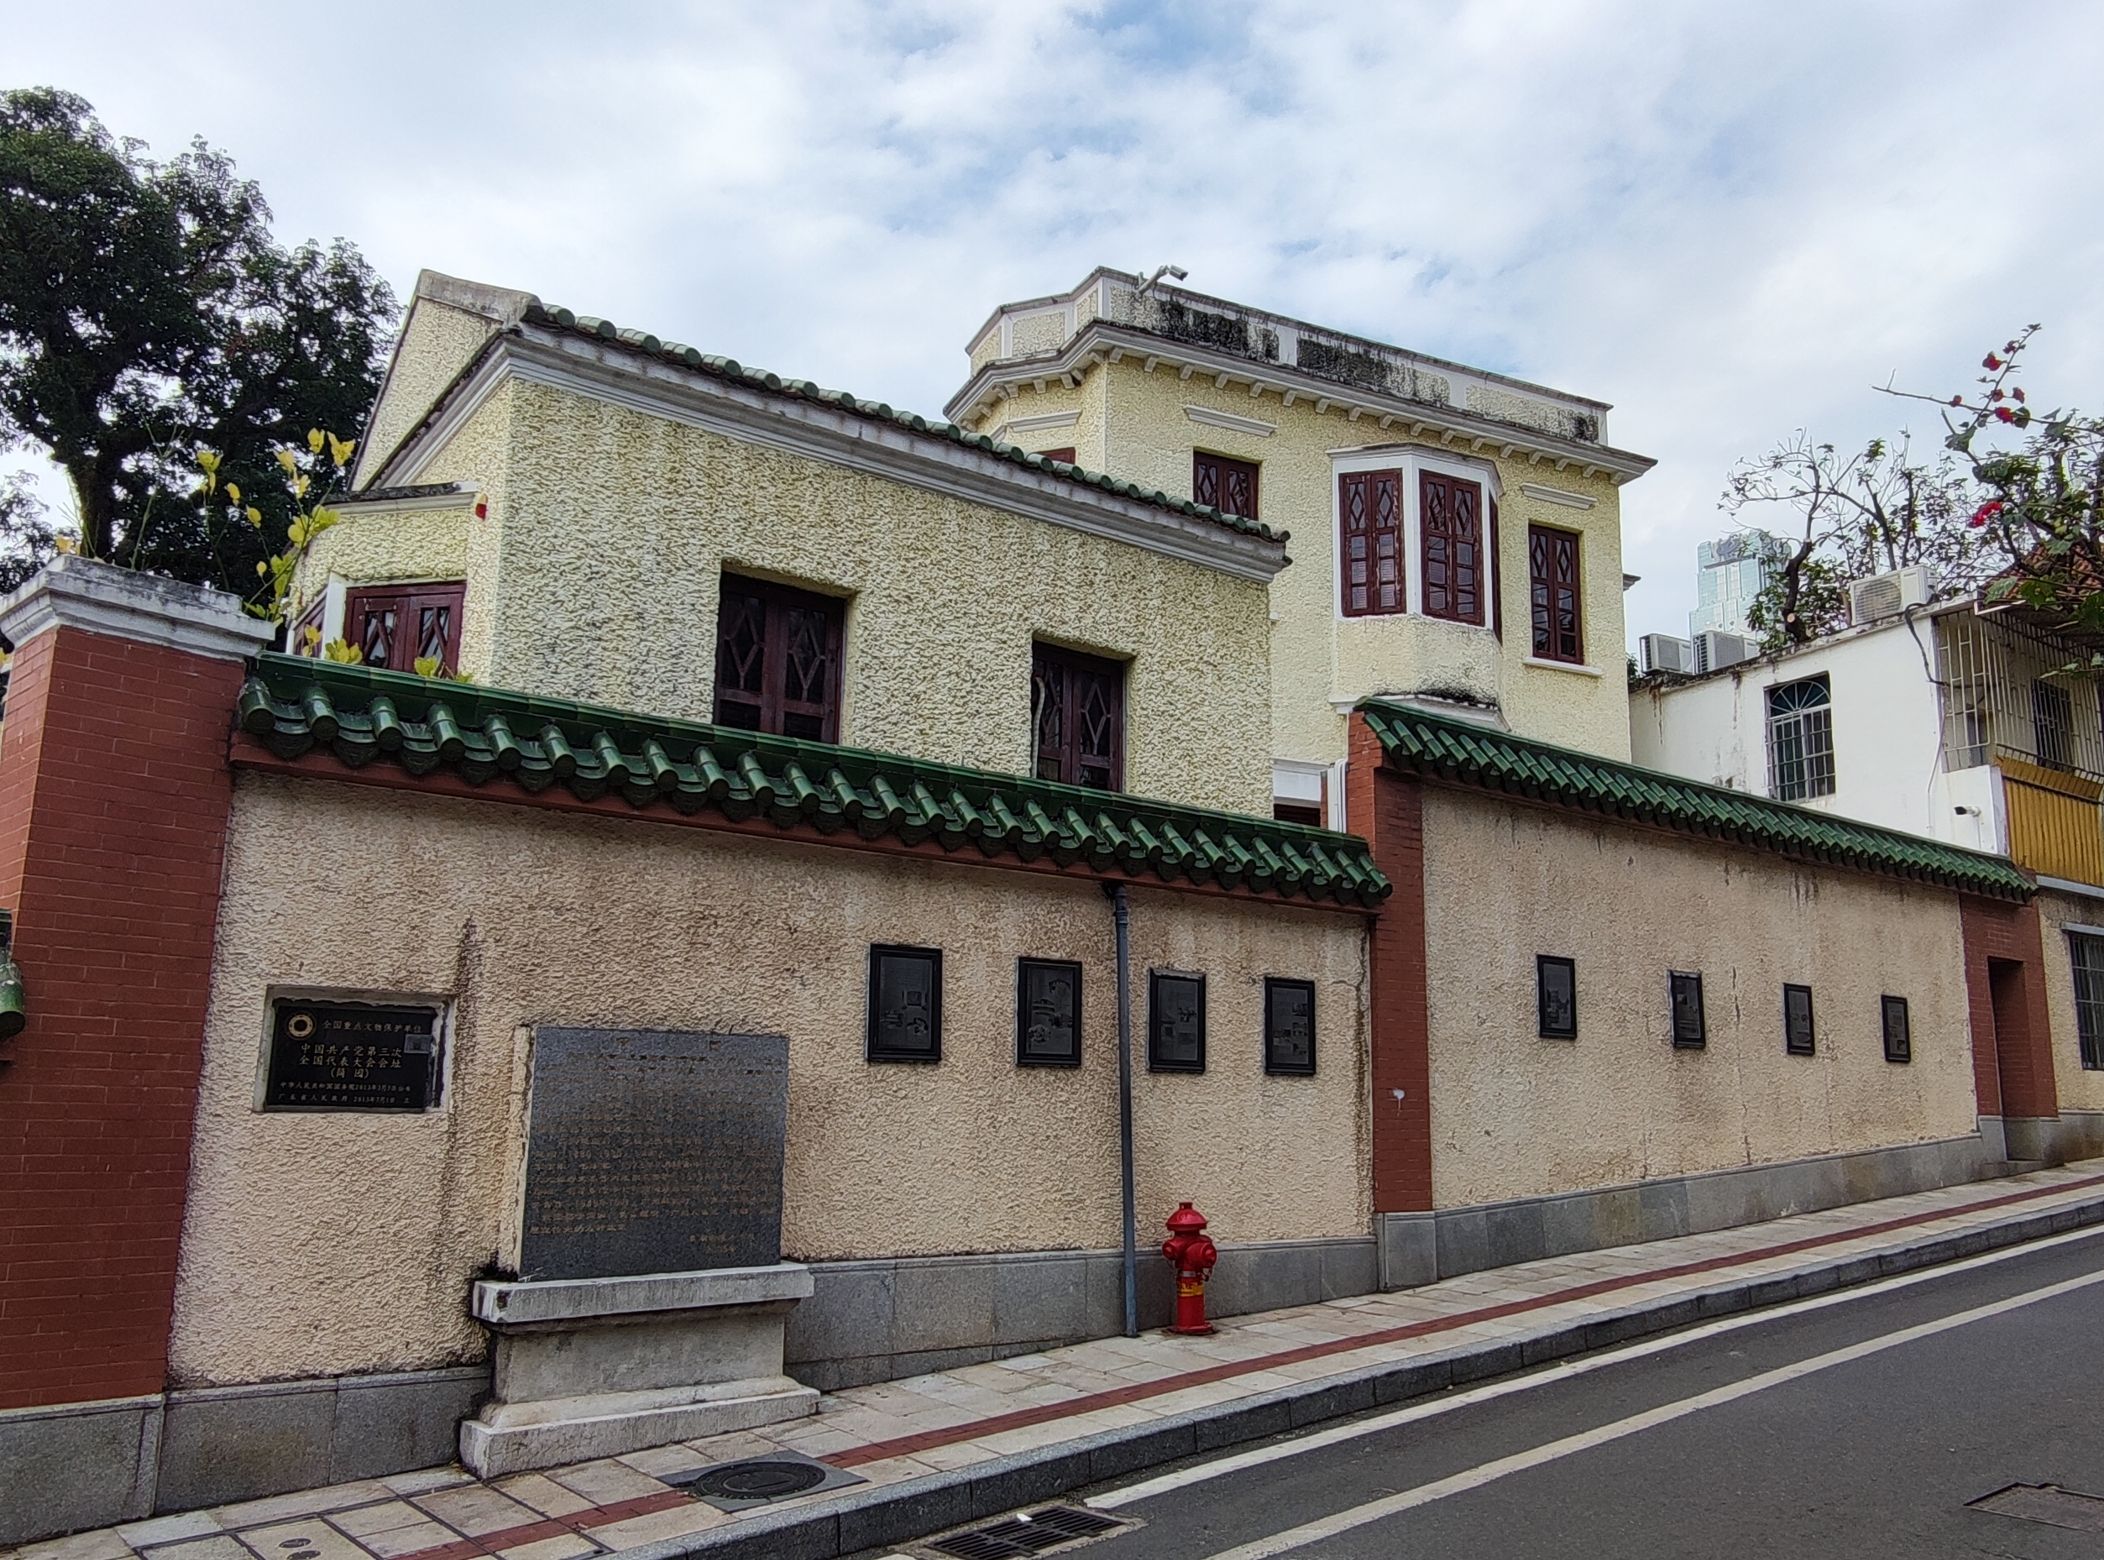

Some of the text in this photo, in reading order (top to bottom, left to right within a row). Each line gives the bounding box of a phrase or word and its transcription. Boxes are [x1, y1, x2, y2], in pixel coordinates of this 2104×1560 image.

[321, 1019, 422, 1033] 全国重点文物保护单位
[301, 1043, 403, 1058] 中国共产党第三次
[299, 1055, 402, 1069] 全国代表大会会址
